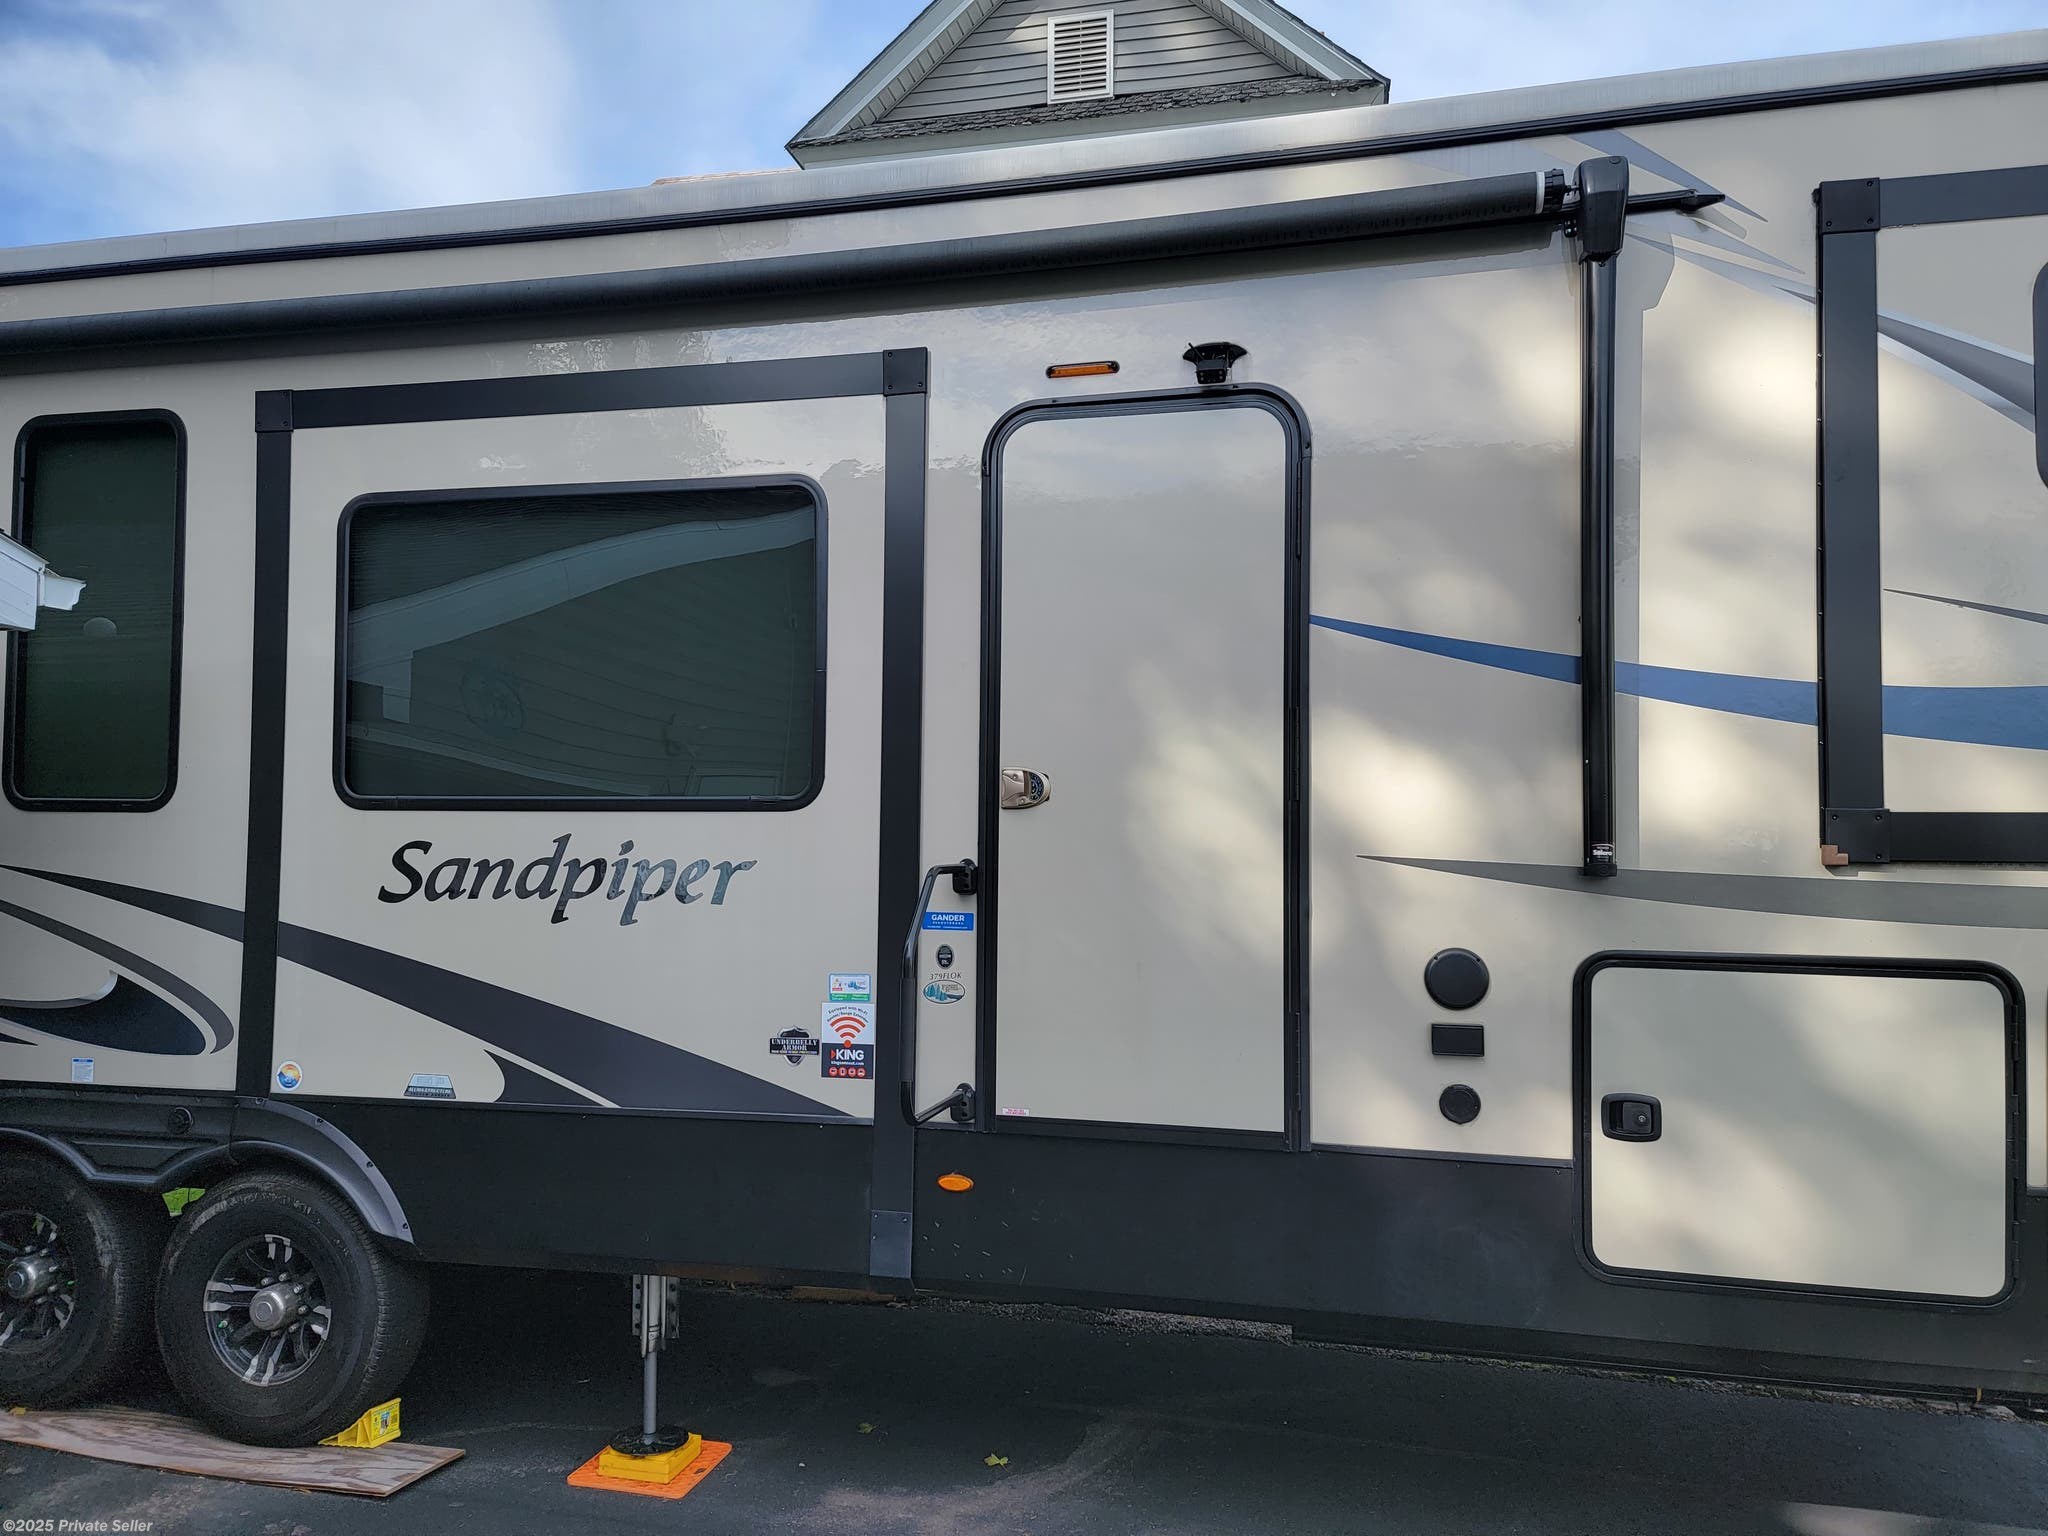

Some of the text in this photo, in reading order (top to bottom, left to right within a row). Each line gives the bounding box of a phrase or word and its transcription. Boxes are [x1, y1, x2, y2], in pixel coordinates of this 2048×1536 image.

[378, 833, 758, 926] Sandpiper
[931, 914, 965, 922] GANDER
[771, 1038, 818, 1046] UNDERBELLY
[835, 1049, 865, 1061] KING
